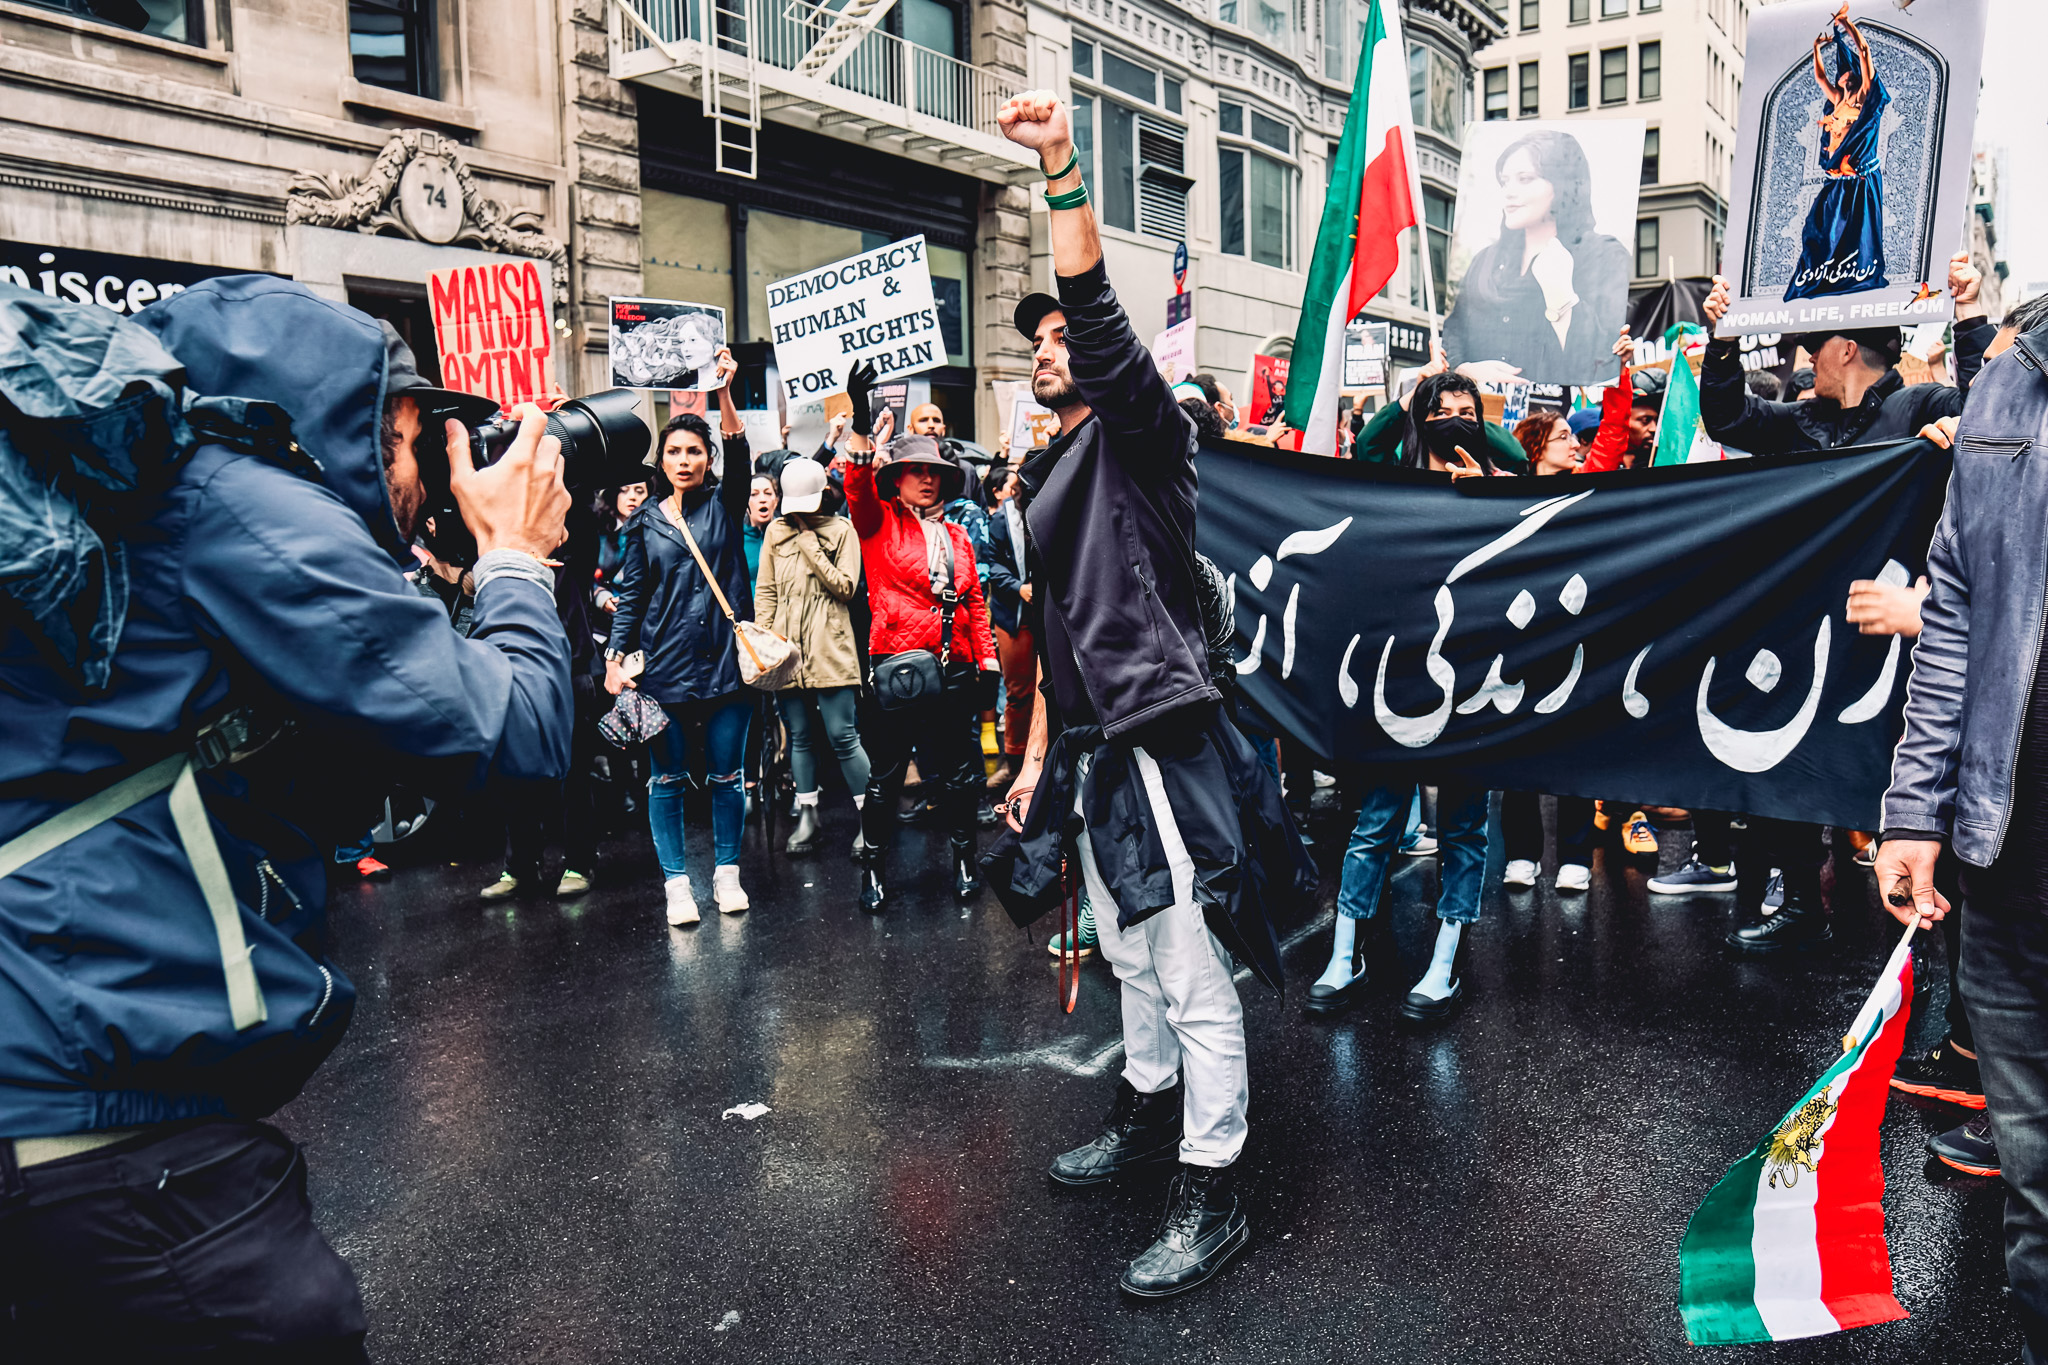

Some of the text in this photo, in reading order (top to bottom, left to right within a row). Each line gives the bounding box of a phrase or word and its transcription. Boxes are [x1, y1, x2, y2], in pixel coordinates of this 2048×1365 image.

[423, 182, 447, 208] 74
[769, 241, 922, 308] DEMOCRACY
[882, 276, 901, 297] &
[1794, 258, 1835, 287] آزادی
[432, 261, 551, 356] MAHSA
[774, 298, 867, 344] HUMAN
[1722, 298, 1945, 328] WOMAN, LIFE, FREEDOM
[839, 308, 935, 354] RIGHTS
[785, 368, 838, 399] FOR
